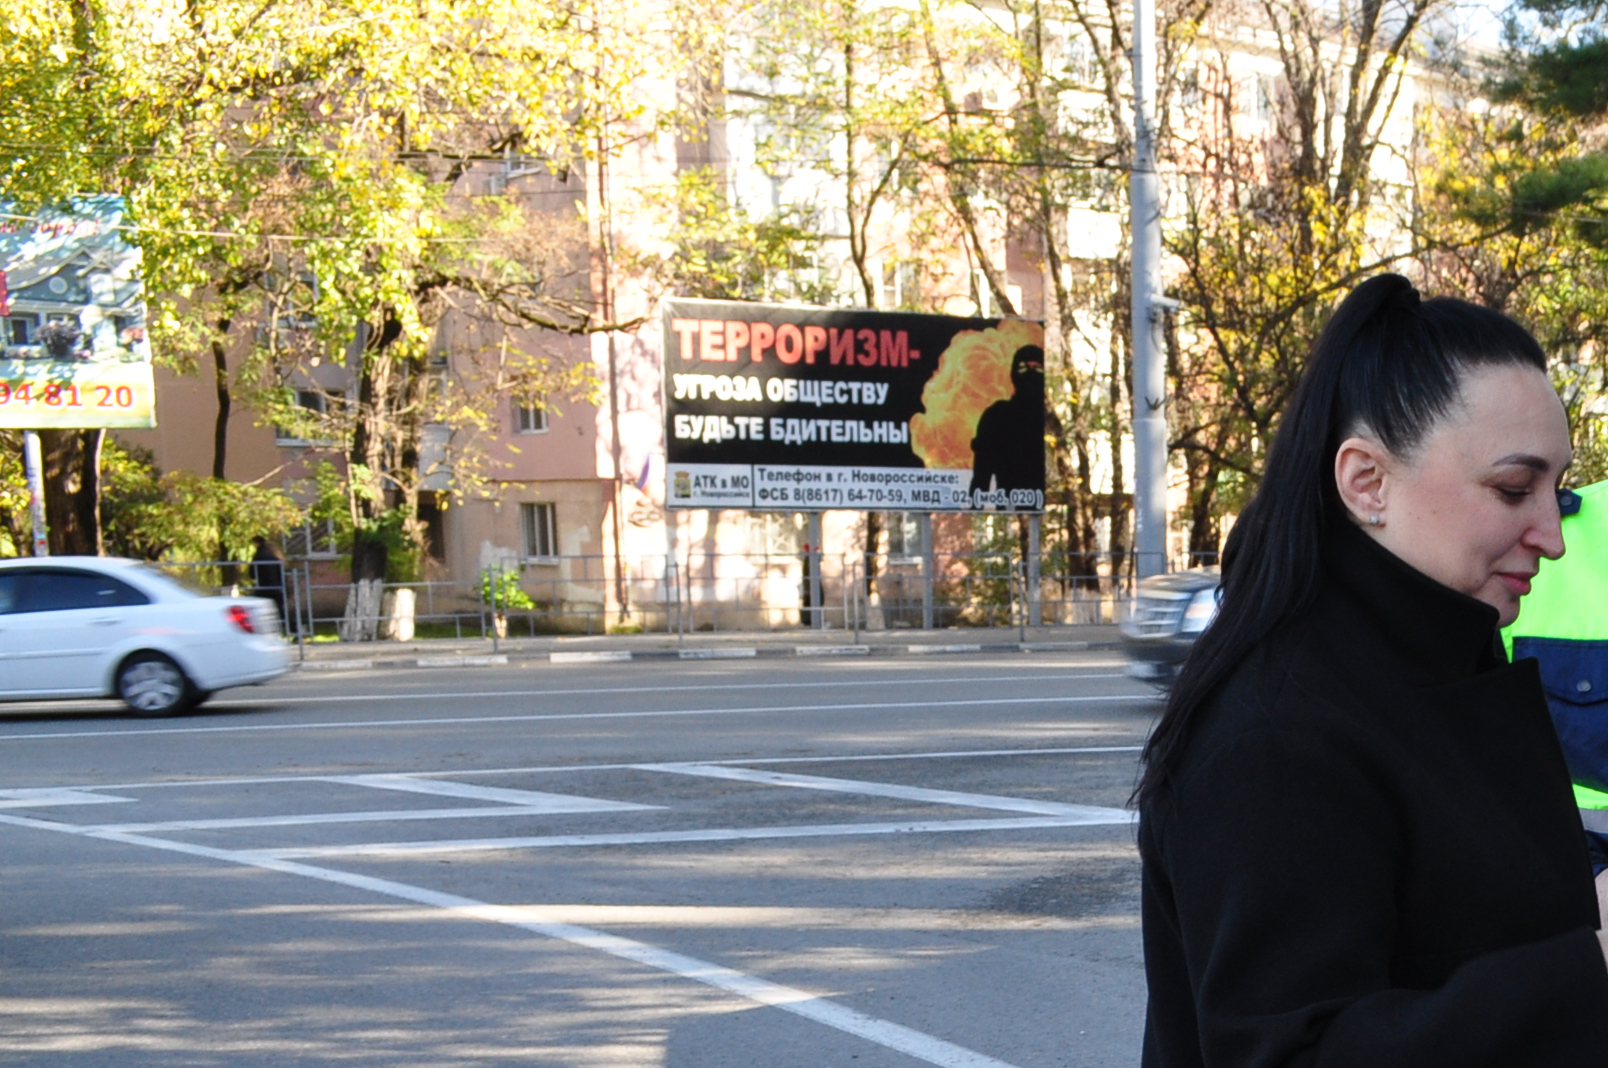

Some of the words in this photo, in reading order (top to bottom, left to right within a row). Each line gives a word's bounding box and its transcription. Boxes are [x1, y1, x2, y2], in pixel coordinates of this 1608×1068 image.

[671, 318, 921, 368] ТЕРРОРИЗМ-
[44, 382, 82, 406] 81
[95, 385, 132, 408] 20
[673, 373, 763, 402] УГРОЗА
[766, 377, 889, 407] ОБЩЕСТВУ
[674, 414, 764, 444] БУДЬТЕ
[769, 417, 909, 446] БДИТЕЛЬНЫ
[693, 475, 717, 489] АТК
[721, 478, 727, 489] в
[731, 475, 750, 489] МО
[757, 467, 822, 486] Телефон
[825, 471, 833, 482] в
[837, 472, 847, 483] г.
[851, 469, 960, 486] Новороссийске:
[758, 487, 789, 501] ФСБ
[793, 488, 844, 505] 8(8617)
[847, 488, 907, 504] 64-70-59,
[911, 489, 942, 504] МВД
